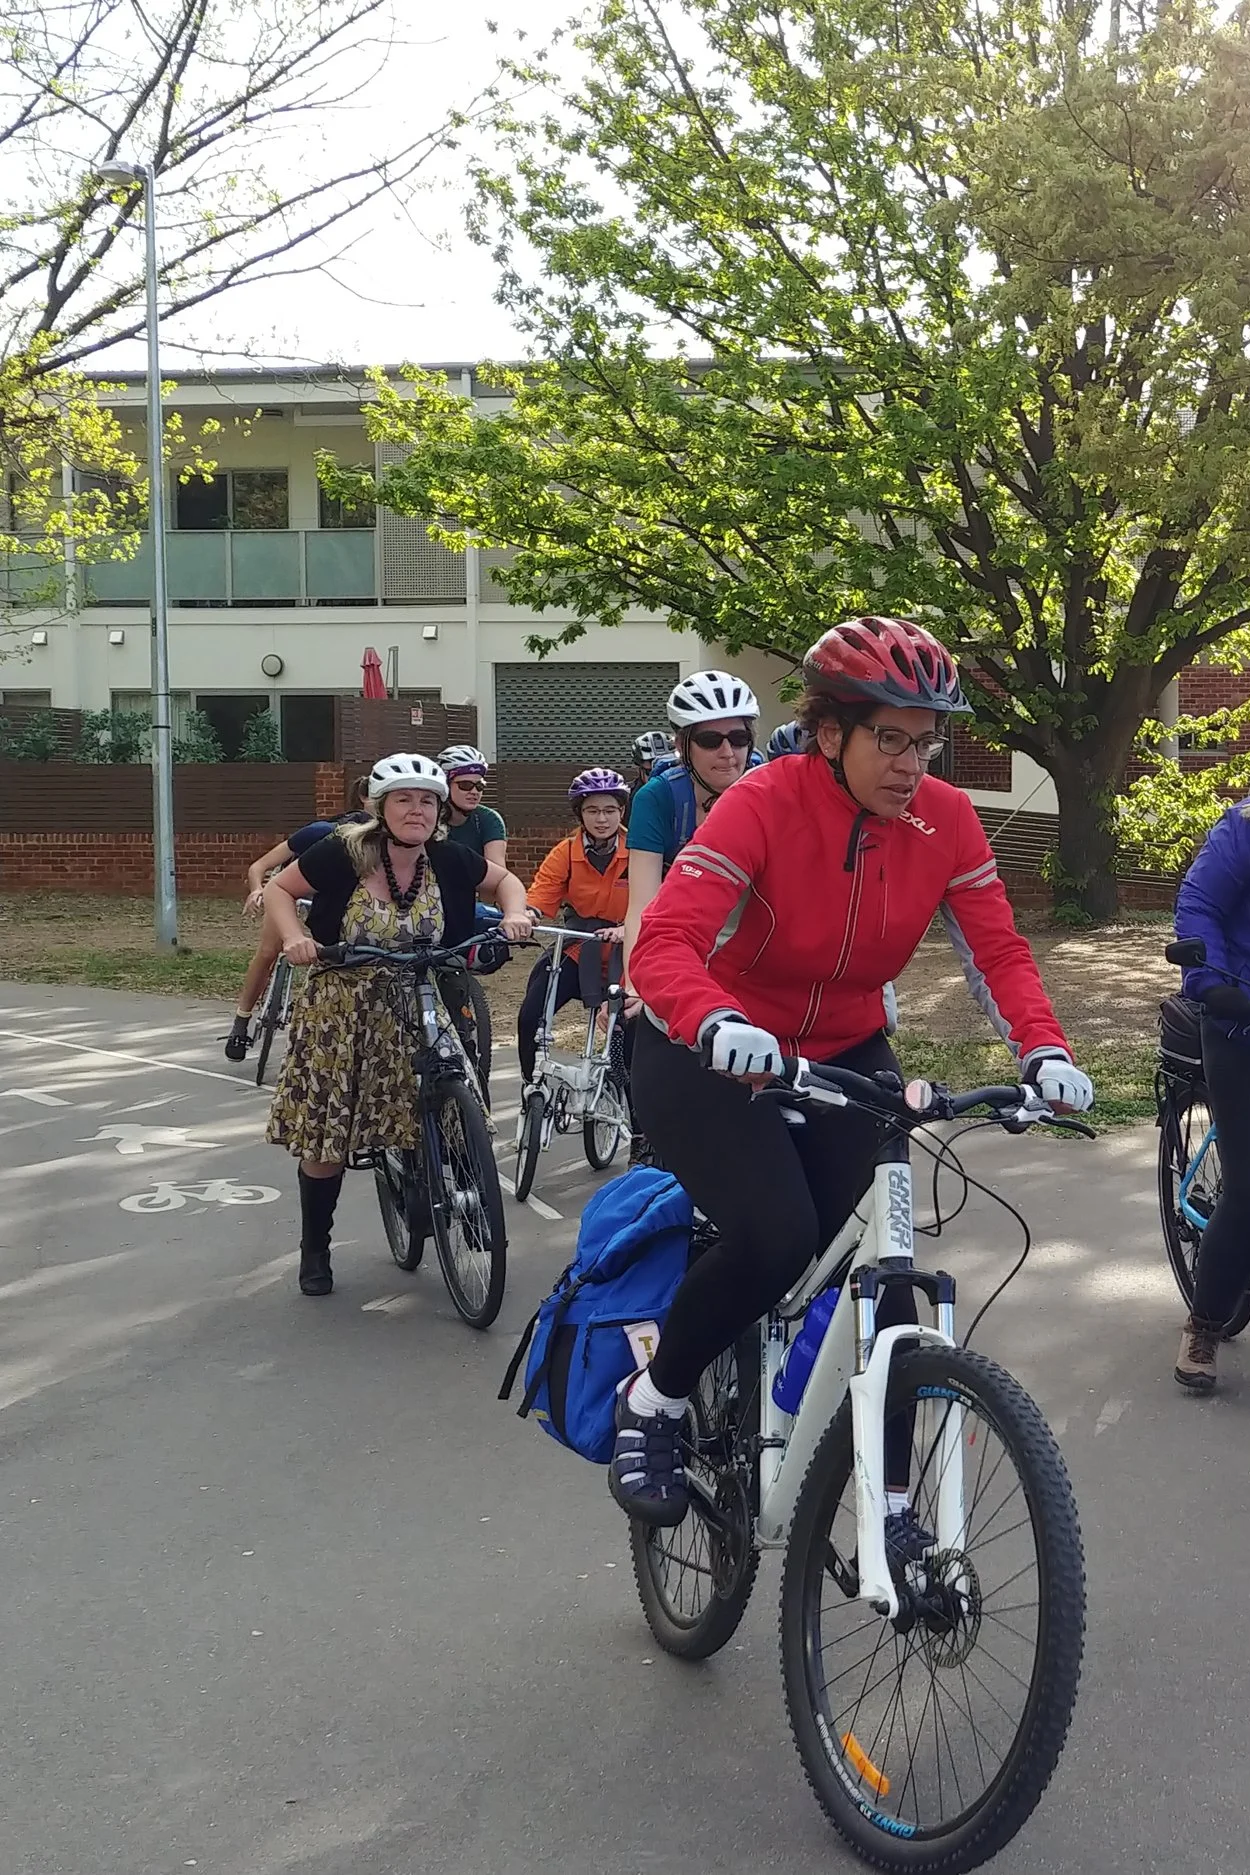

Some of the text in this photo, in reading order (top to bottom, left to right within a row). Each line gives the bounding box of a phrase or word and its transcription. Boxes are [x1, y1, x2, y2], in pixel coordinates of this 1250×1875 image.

[888, 1169, 904, 1249] GIANT
[899, 1169, 912, 1249] GIANT
[917, 1385, 960, 1399] GIANT
[872, 1813, 917, 1837] GIANT
